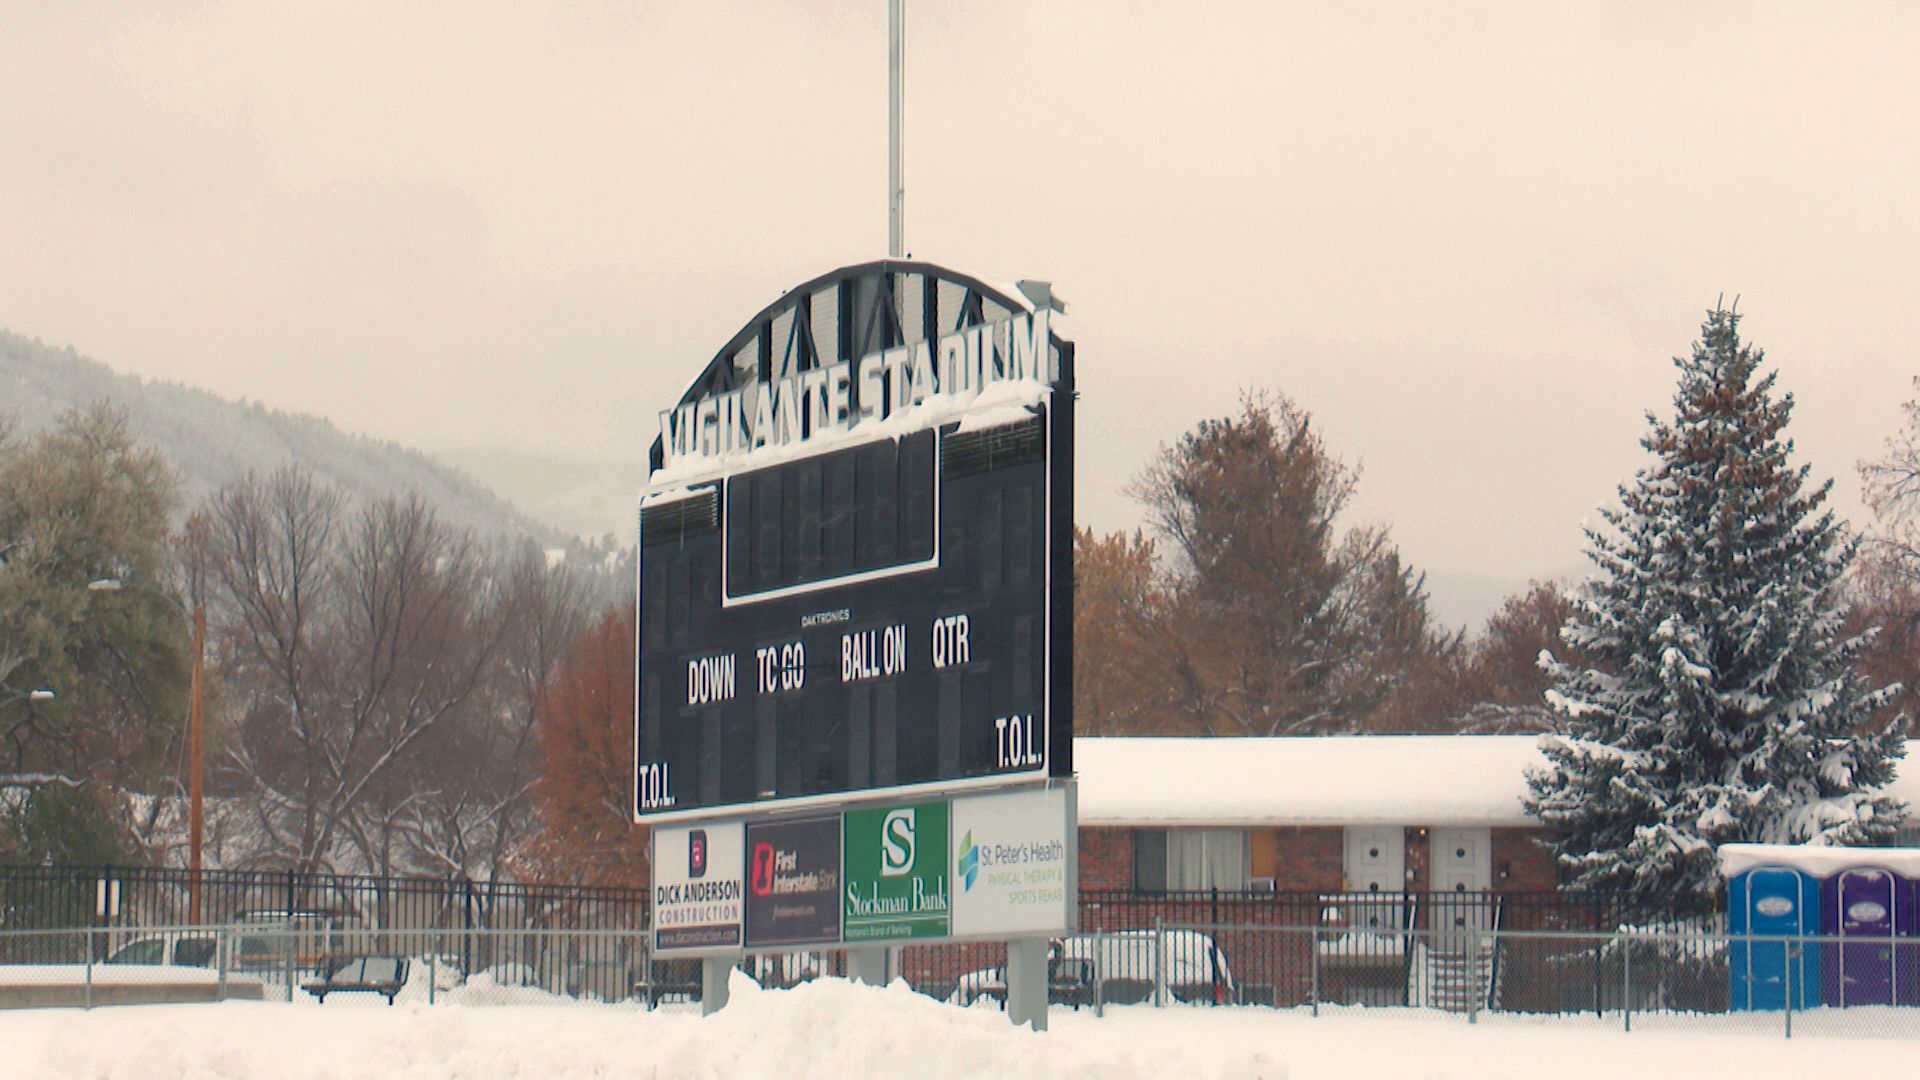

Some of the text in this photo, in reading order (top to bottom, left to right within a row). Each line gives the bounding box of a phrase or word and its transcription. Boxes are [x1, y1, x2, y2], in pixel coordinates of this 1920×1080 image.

[659, 308, 1051, 462] VIGILANTE STADIUM
[841, 624, 907, 682] BALL ON
[932, 614, 971, 668] QTR
[687, 653, 736, 705] DOWN
[781, 641, 806, 690] GO
[995, 714, 1042, 768] T.O.L.
[639, 762, 676, 808] T.O.L.
[775, 850, 797, 871] First
[1031, 840, 1064, 862] Health
[657, 879, 740, 905] DICK ANDERSON
[658, 904, 738, 924] CONSTRUCTION
[847, 880, 909, 916] Stockman
[912, 875, 948, 912] Bank
